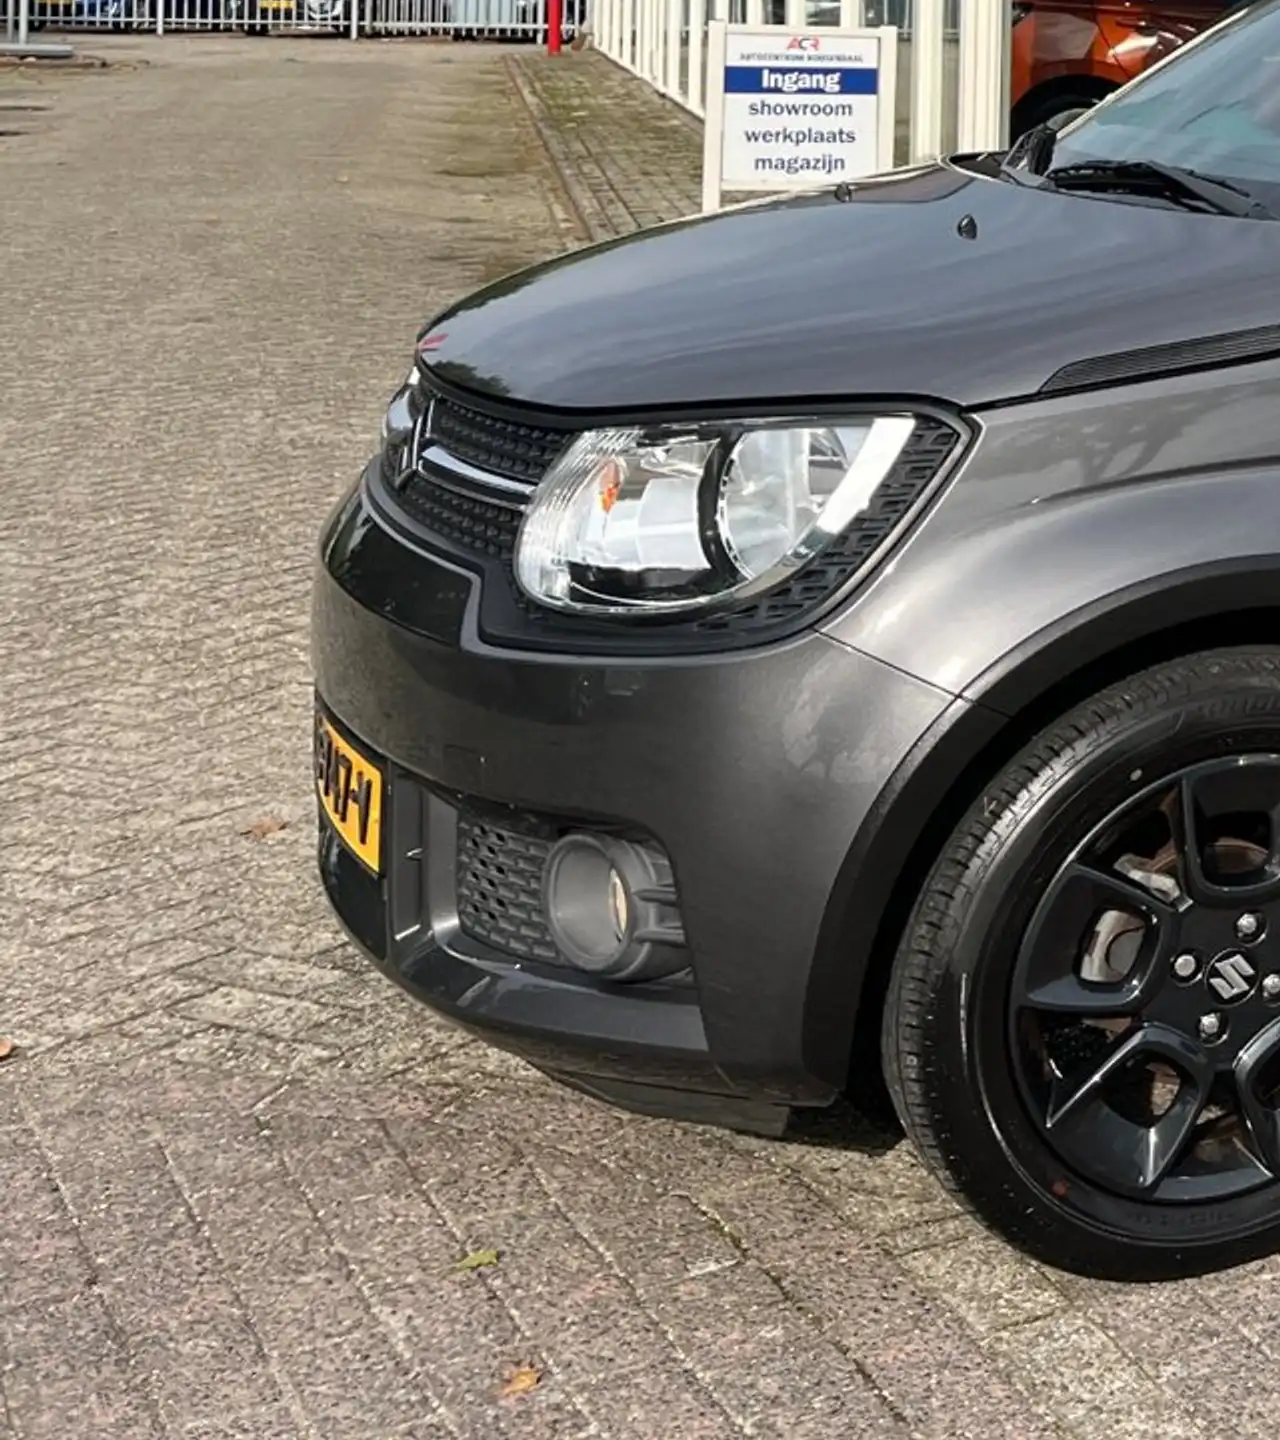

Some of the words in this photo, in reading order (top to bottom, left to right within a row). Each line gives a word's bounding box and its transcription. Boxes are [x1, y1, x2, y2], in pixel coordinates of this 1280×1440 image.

[787, 36, 820, 51] ACR
[761, 68, 842, 92] Ingang
[748, 100, 853, 117] showroom
[744, 127, 856, 147] werkplaats
[754, 153, 846, 174] magazijn
